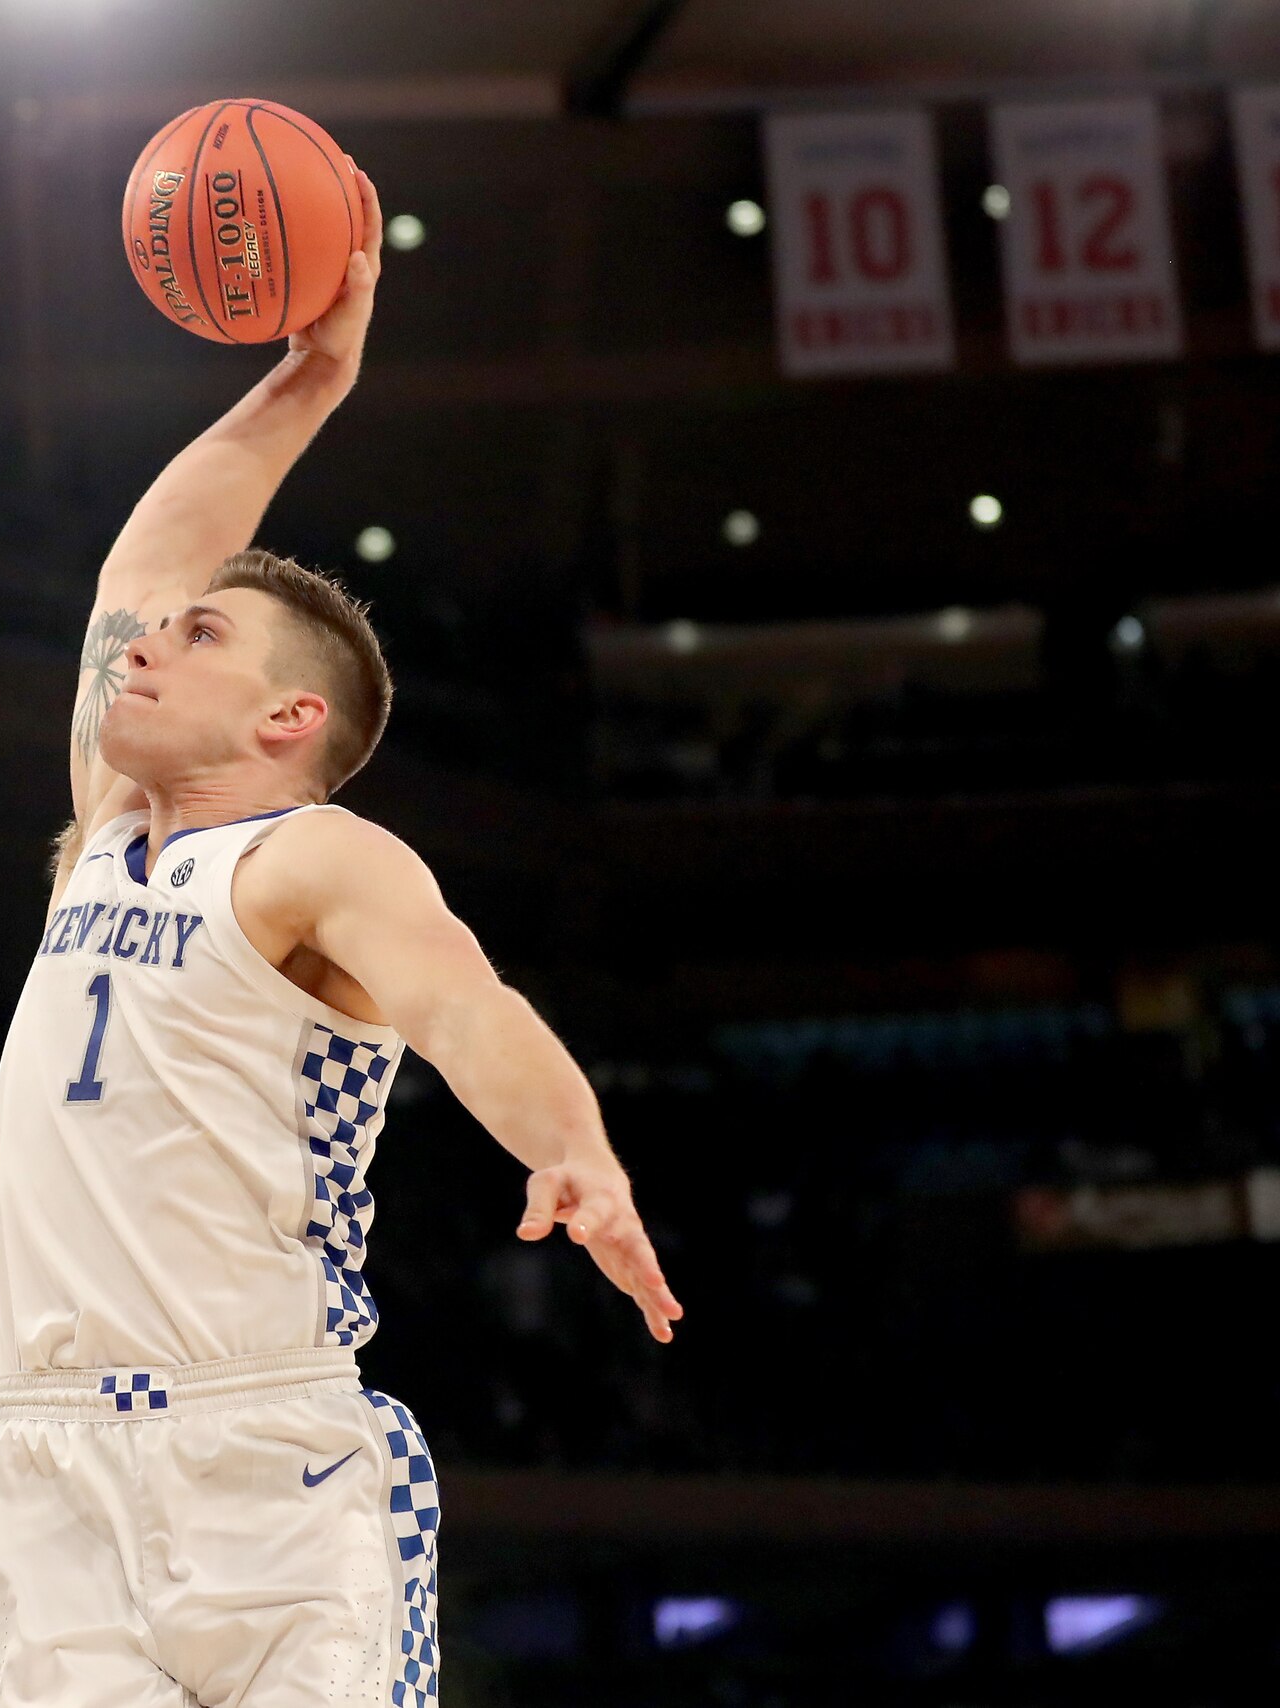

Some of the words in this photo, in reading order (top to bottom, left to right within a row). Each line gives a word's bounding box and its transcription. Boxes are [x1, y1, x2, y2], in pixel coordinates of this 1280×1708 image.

[150, 170, 207, 325] SPALDING
[212, 170, 254, 321] TF-1000
[243, 219, 262, 279] LEGACY
[257, 190, 268, 226] DESIGN
[803, 184, 912, 285] 10
[1029, 173, 1139, 274] 12
[171, 859, 194, 886] SEC
[63, 971, 112, 1105] 1
